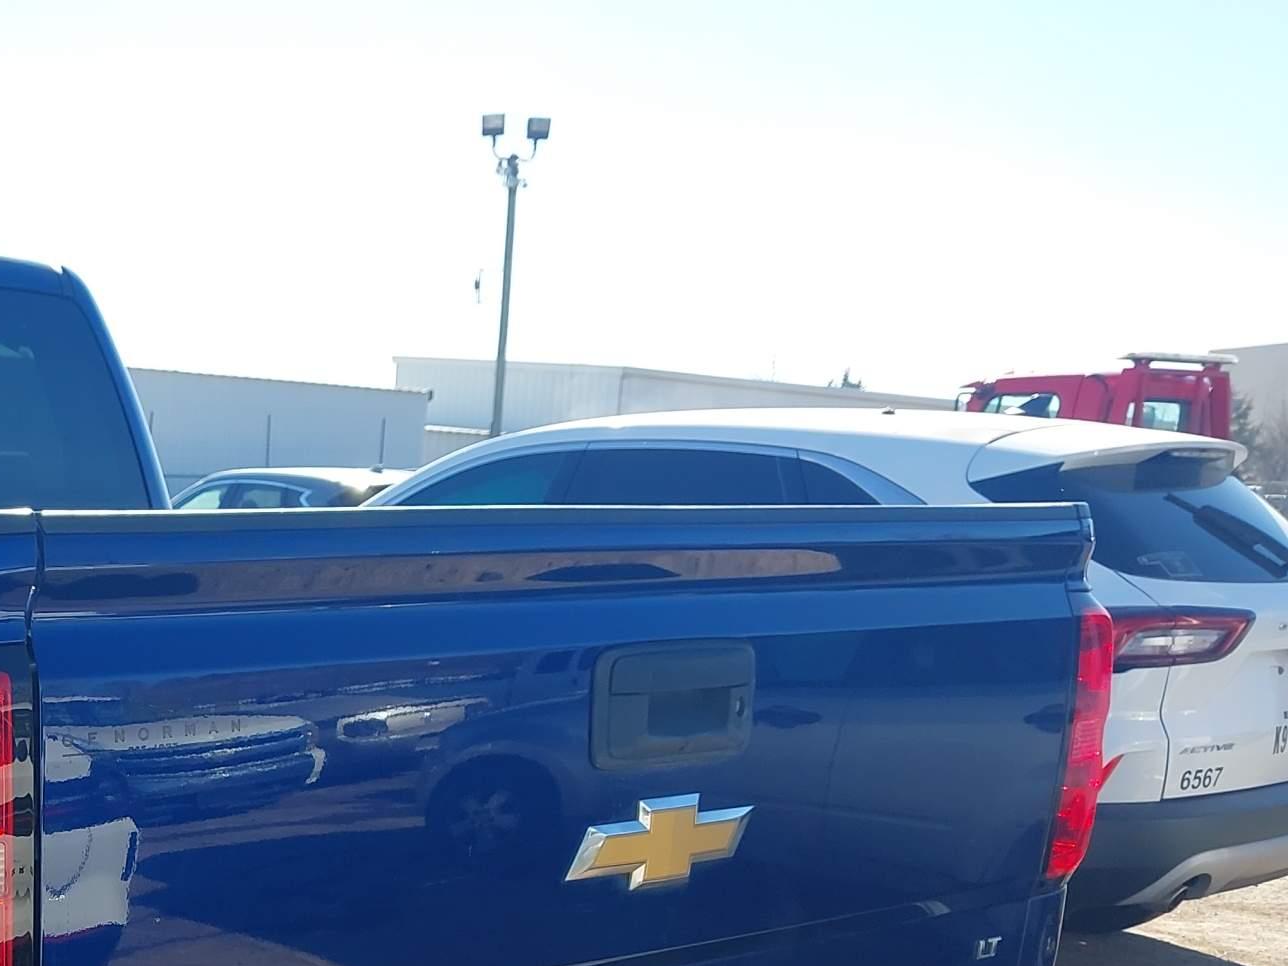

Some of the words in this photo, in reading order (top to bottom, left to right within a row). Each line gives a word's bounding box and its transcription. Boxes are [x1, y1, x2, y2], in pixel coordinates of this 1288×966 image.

[114, 718, 242, 744] NORMAN
[1179, 742, 1236, 755] ACTIVE
[1180, 766, 1225, 791] 6567
[976, 936, 1003, 960] LT
